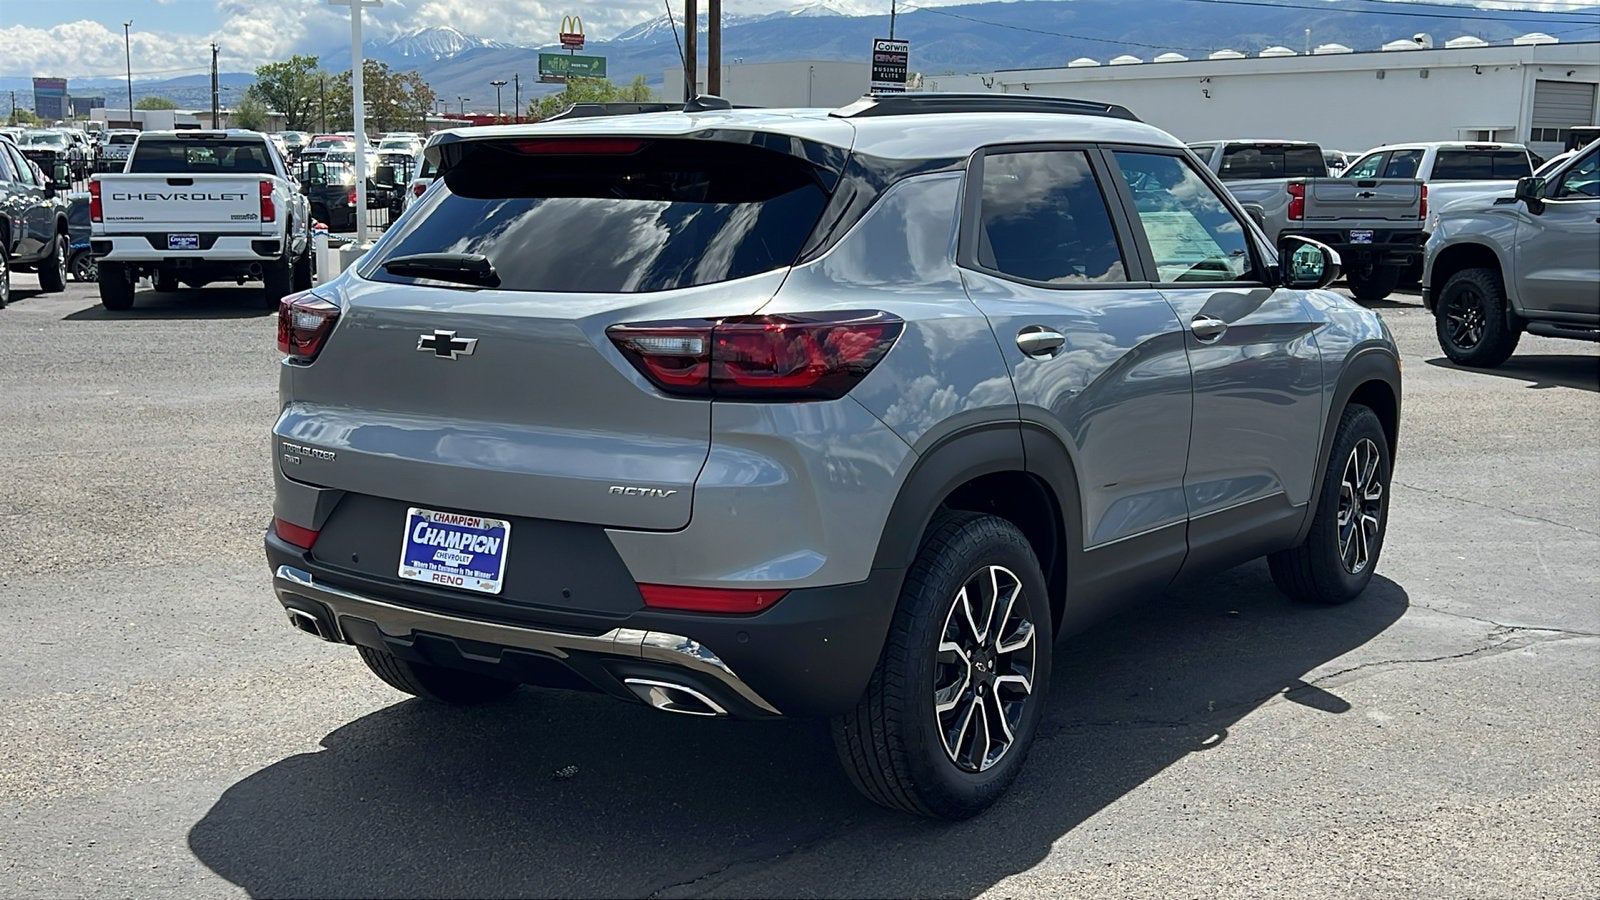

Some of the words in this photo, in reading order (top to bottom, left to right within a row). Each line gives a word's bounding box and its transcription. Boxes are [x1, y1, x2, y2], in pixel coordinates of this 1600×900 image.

[878, 42, 908, 52] Corwin
[874, 54, 906, 63] GMC
[112, 193, 249, 201] CHEVROLET
[282, 442, 336, 462] TRAILBLAZER
[608, 485, 678, 498] ACTIV
[433, 512, 481, 528] CHAMPION
[412, 521, 501, 556] CHAMPION
[436, 551, 471, 563] CHEVROLET
[428, 562, 437, 570] The
[464, 568, 474, 577] The
[431, 573, 464, 586] RENO
